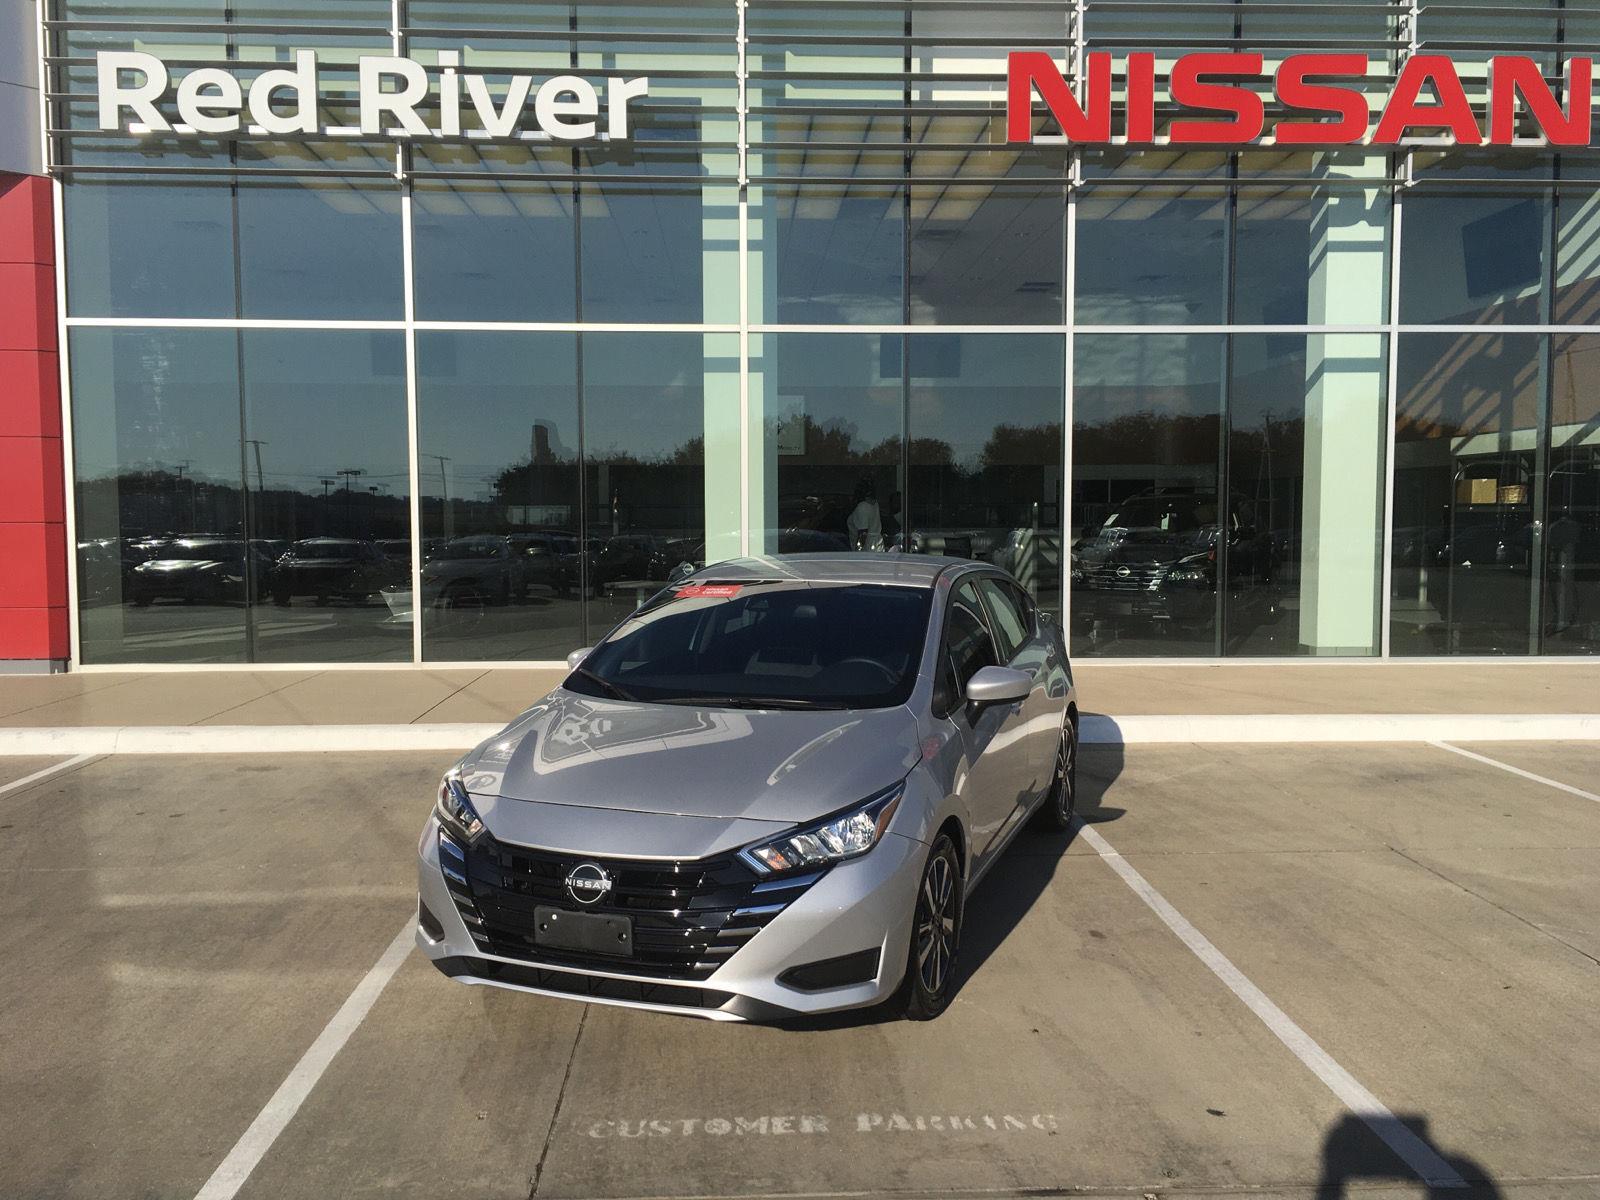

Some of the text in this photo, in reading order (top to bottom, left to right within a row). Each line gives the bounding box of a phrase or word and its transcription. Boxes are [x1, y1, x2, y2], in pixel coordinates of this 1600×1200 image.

[96, 49, 649, 140] Red River
[1007, 52, 1591, 145] NISSAN
[565, 877, 611, 890] NISSAN
[588, 1115, 830, 1138] CUSTOMER
